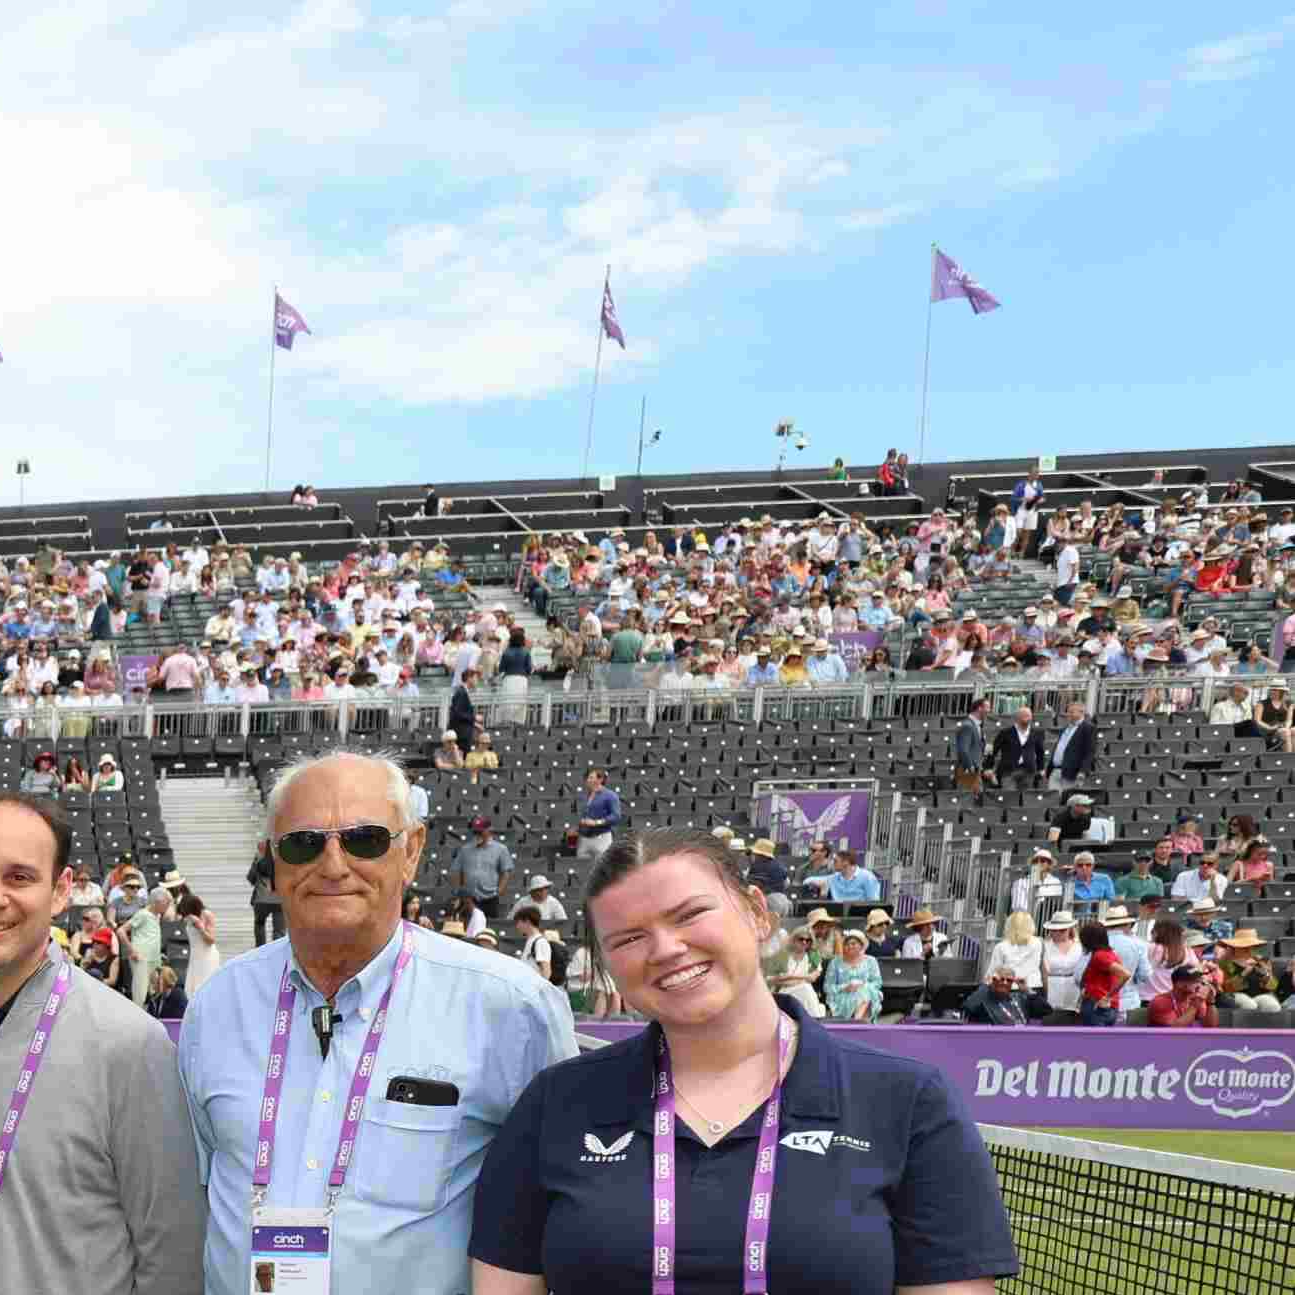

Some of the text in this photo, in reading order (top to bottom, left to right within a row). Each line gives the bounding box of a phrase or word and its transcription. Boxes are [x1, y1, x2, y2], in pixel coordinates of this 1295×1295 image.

[975, 1059, 1181, 1100] Del Monte
[1194, 1068, 1291, 1088] Del Monte
[274, 1233, 304, 1244] cinch
